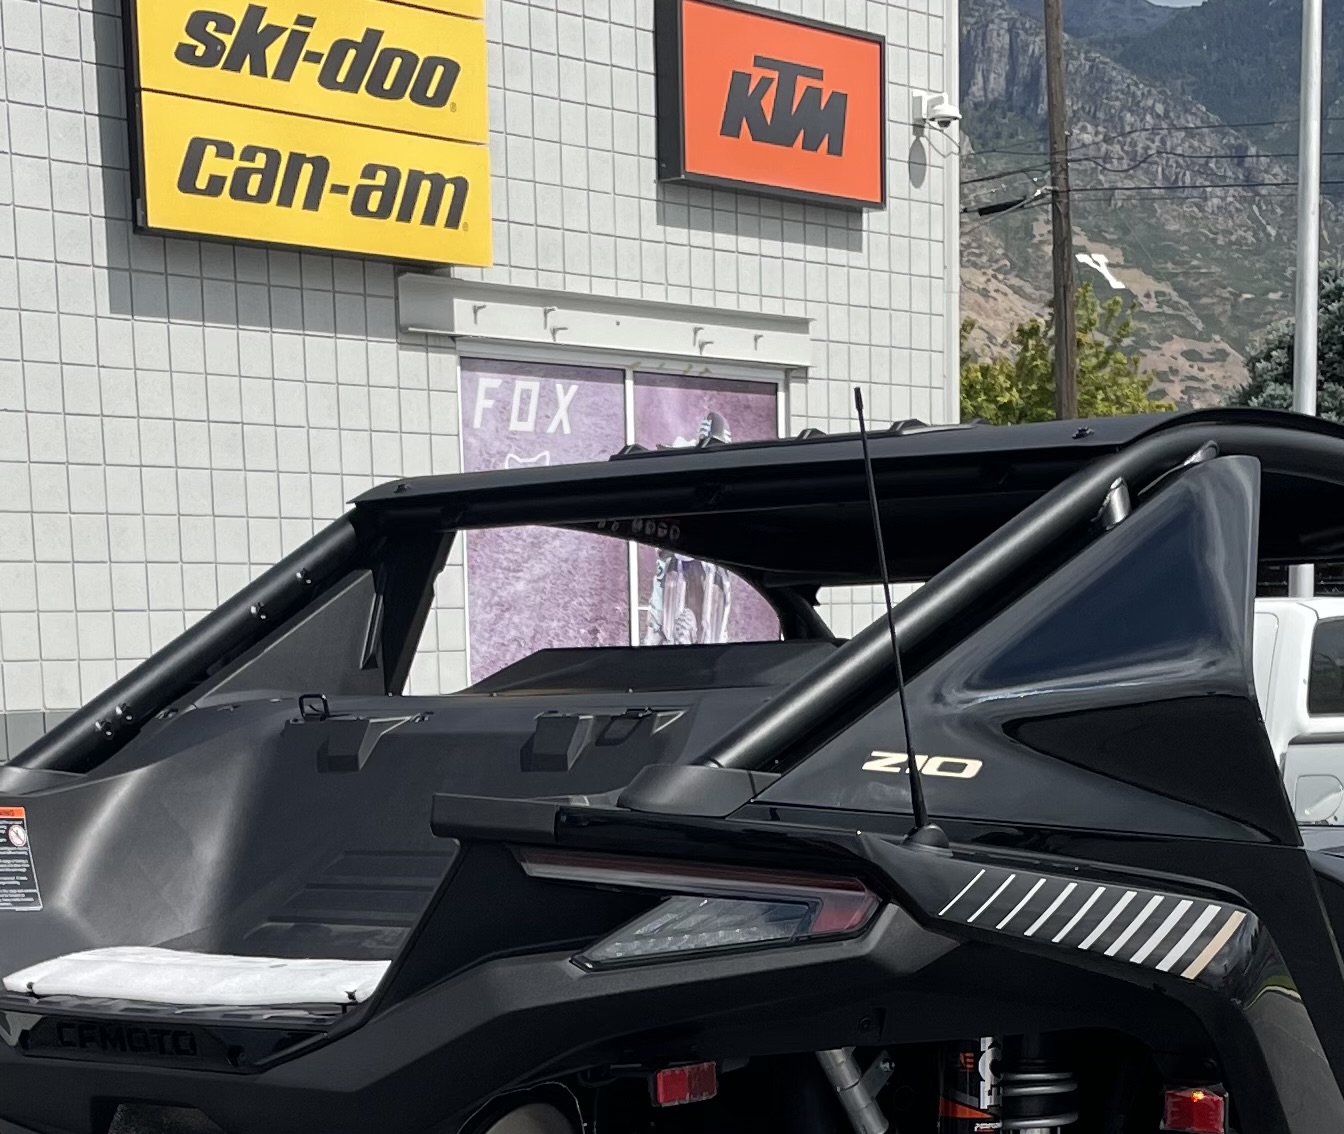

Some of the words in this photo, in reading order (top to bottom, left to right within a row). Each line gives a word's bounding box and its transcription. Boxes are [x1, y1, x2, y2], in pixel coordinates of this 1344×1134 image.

[174, 3, 462, 109] ski-doo
[720, 55, 848, 157] KTM
[177, 136, 470, 231] can-am
[1075, 253, 1126, 289] Y
[472, 378, 579, 435] FOX
[57, 1021, 198, 1057] CFMOTO
